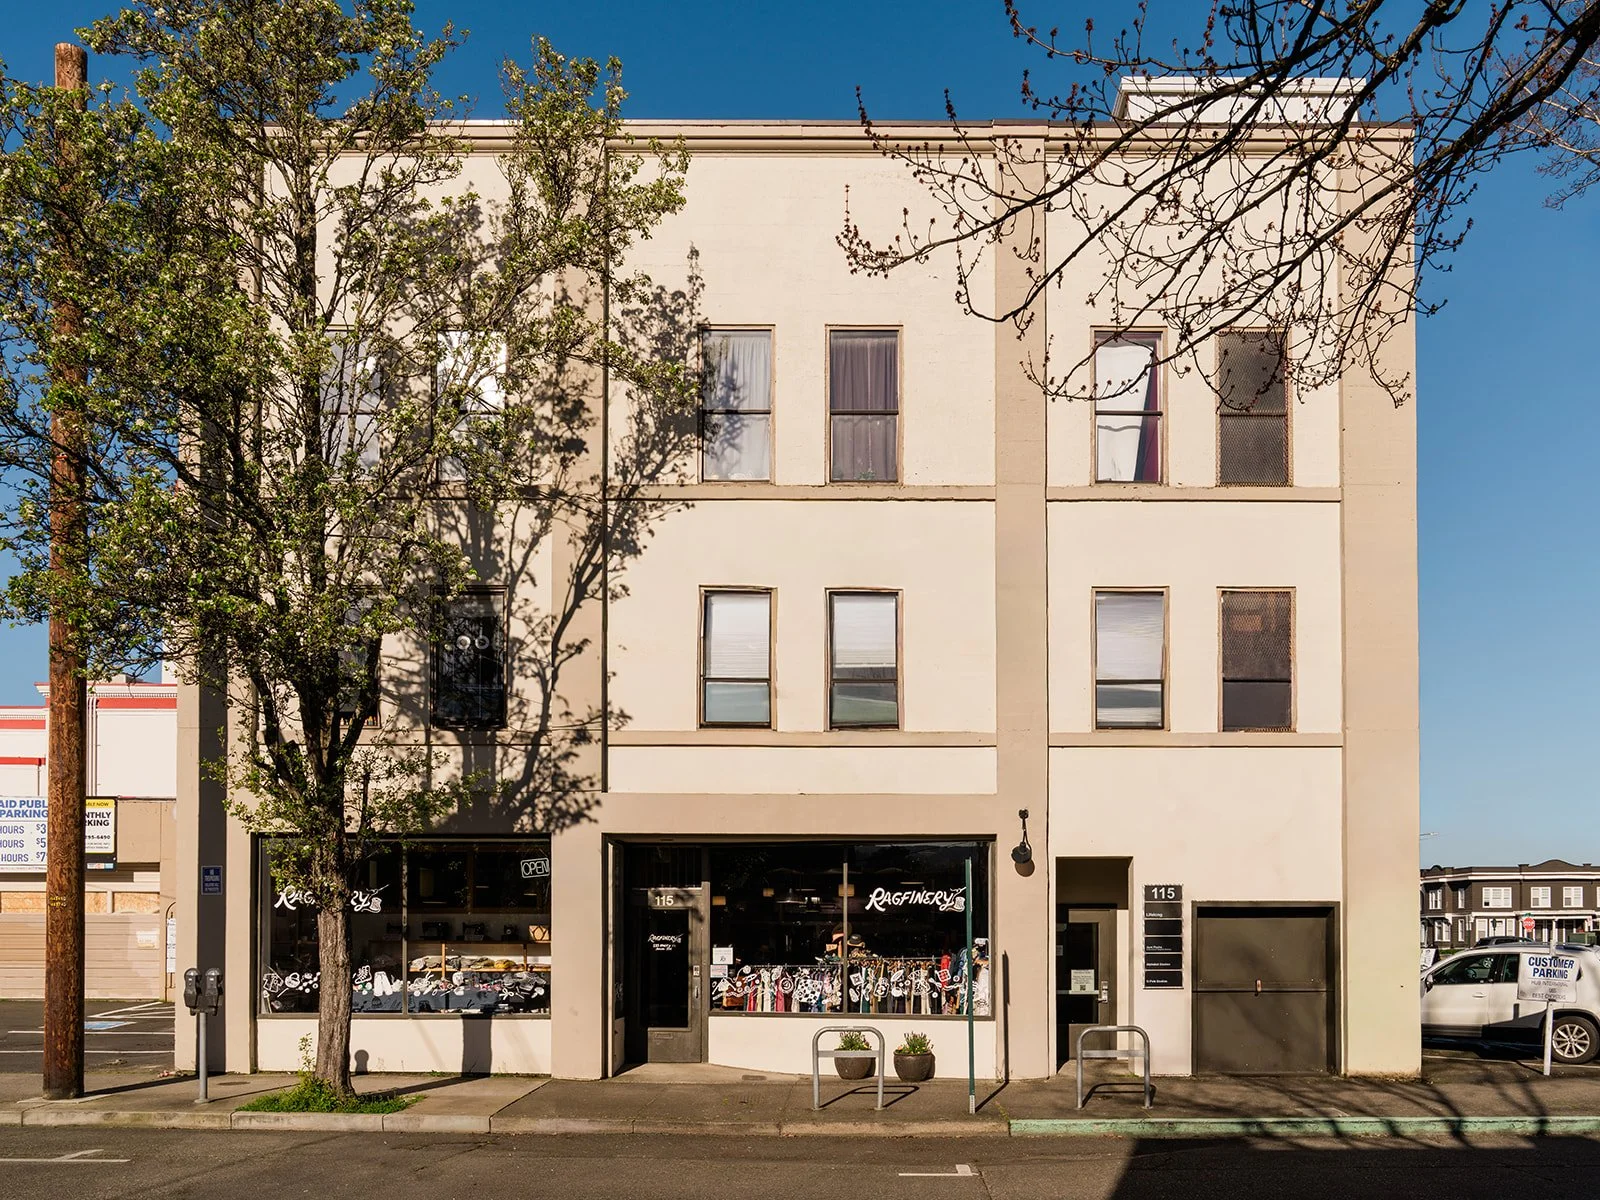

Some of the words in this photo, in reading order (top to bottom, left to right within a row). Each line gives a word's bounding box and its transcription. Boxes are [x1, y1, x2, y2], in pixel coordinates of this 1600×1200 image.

[0, 810, 48, 818] PARKING
[36, 823, 47, 834] $3
[36, 837, 47, 849] $5
[1, 853, 29, 863] HOURS
[36, 851, 46, 862] $7
[522, 860, 549, 876] OPEN
[864, 886, 955, 912] RAGFINERY
[1151, 887, 1176, 900] 115
[654, 895, 674, 906] 115
[1528, 956, 1575, 969] CUSTOMER
[1532, 968, 1568, 978] PARKING
